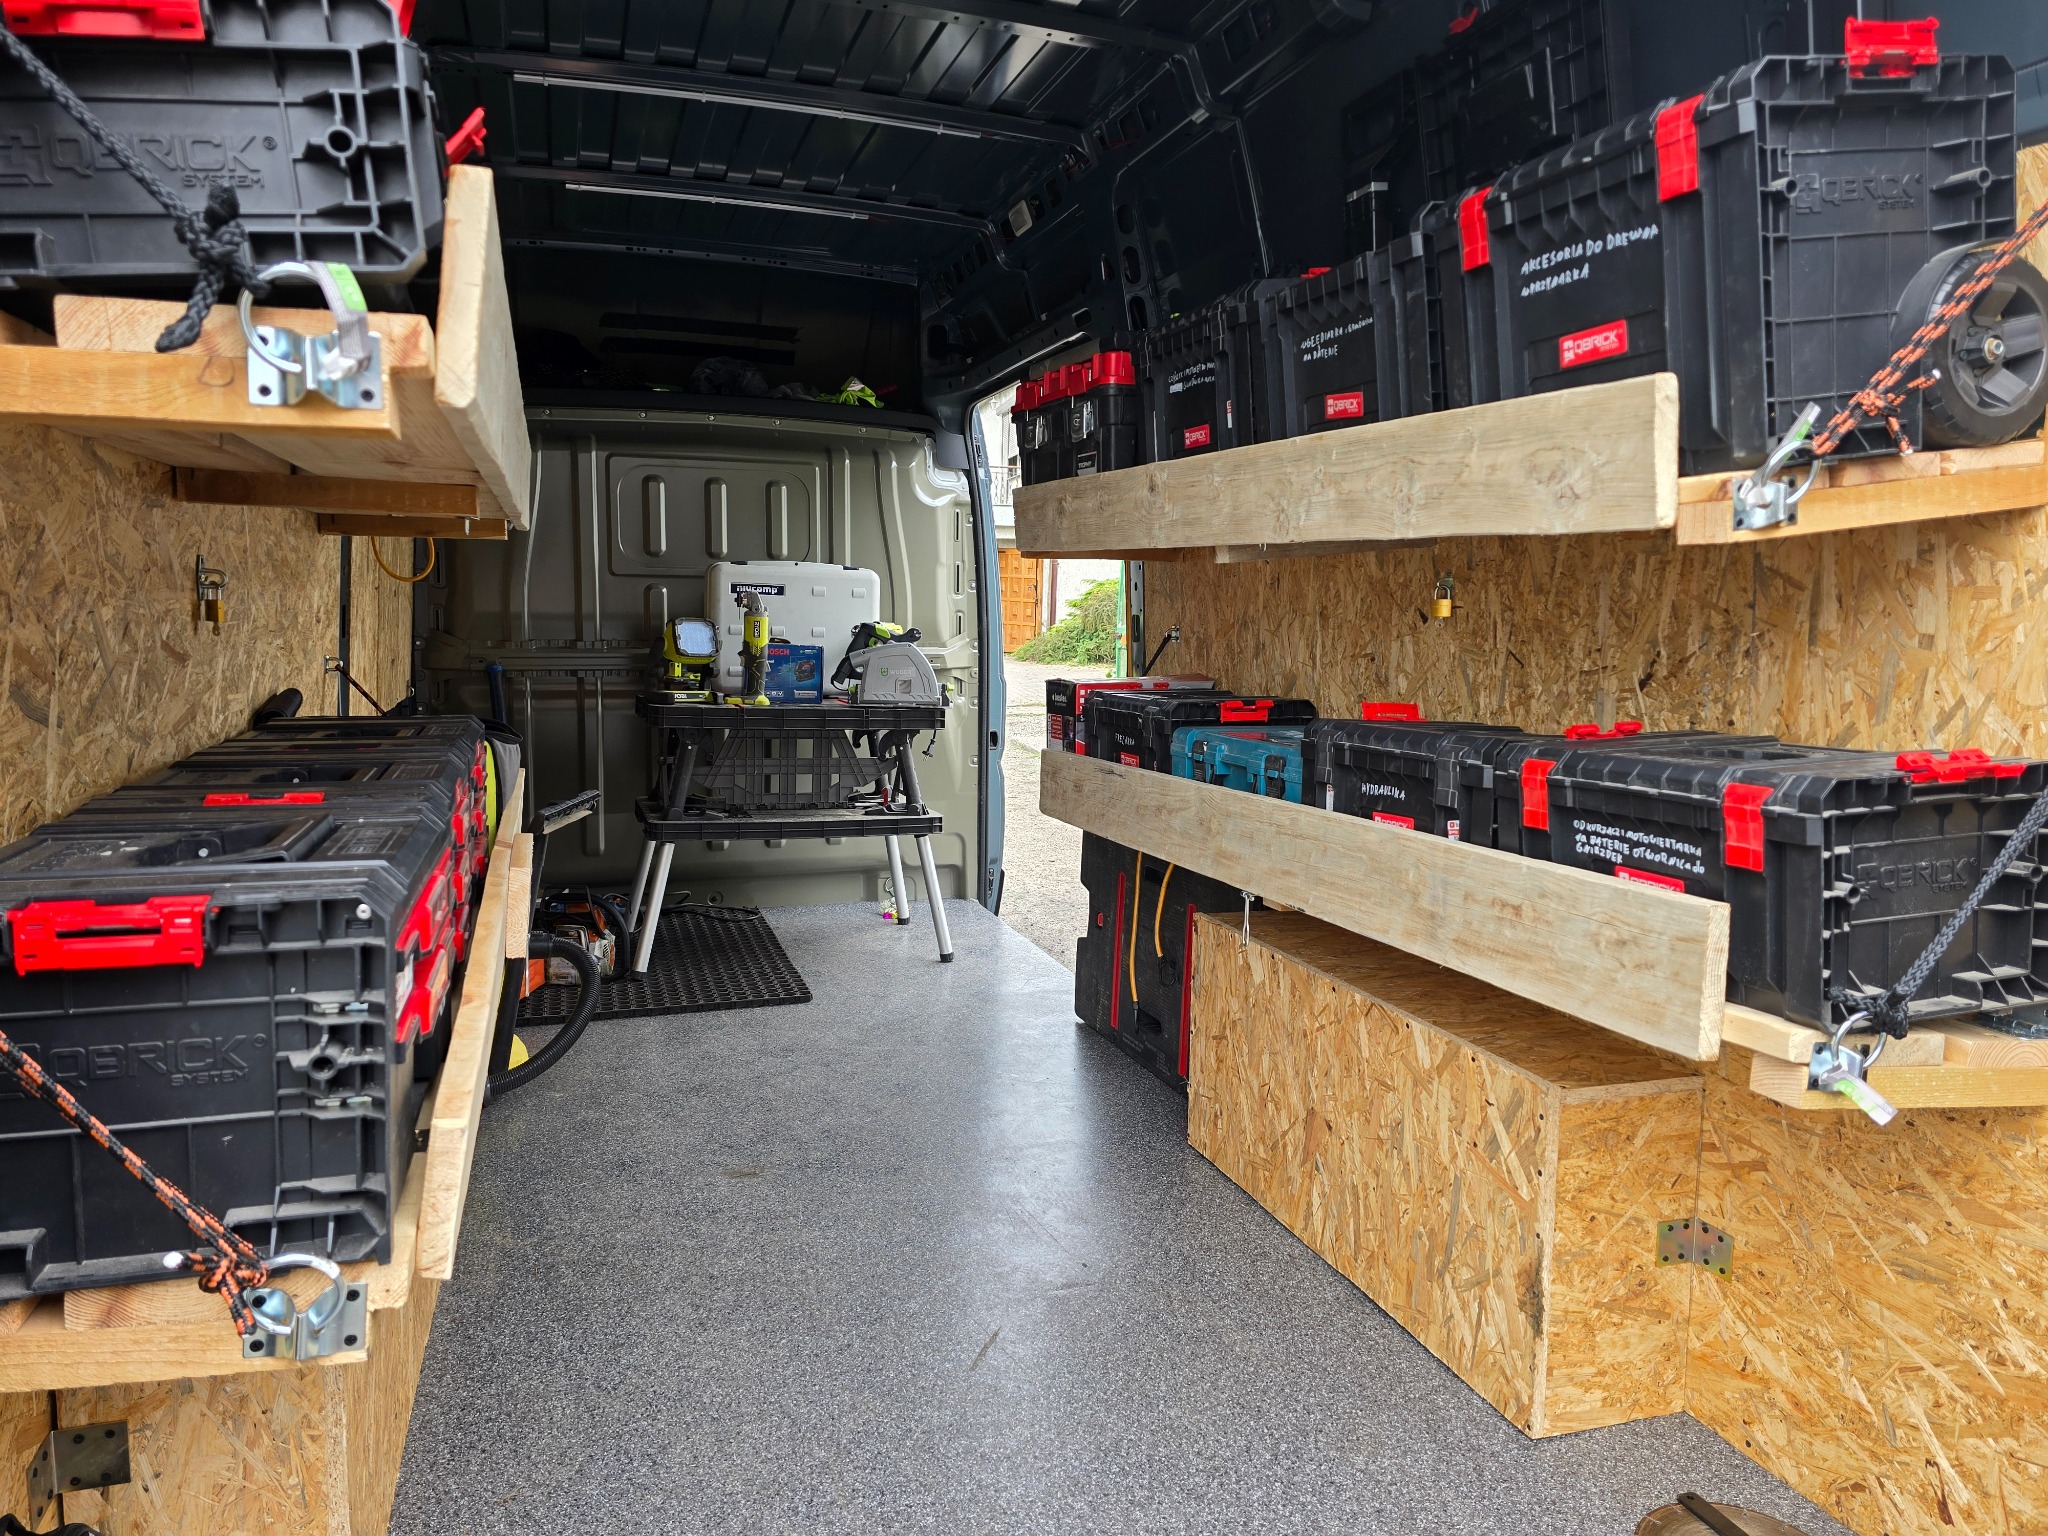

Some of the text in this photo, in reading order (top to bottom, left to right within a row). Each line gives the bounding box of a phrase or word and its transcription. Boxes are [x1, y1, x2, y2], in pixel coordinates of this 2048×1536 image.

[1520, 223, 1659, 275] AKCESORIA DO DREWNA
[1574, 330, 1619, 355] QBRICK
[1333, 399, 1358, 412] QBRICK
[1361, 782, 1406, 801] HYDRAULIKA
[1880, 858, 1967, 892] QBRICK
[50, 1034, 248, 1086] QBRICK
[171, 1068, 249, 1086] SYSTEM
